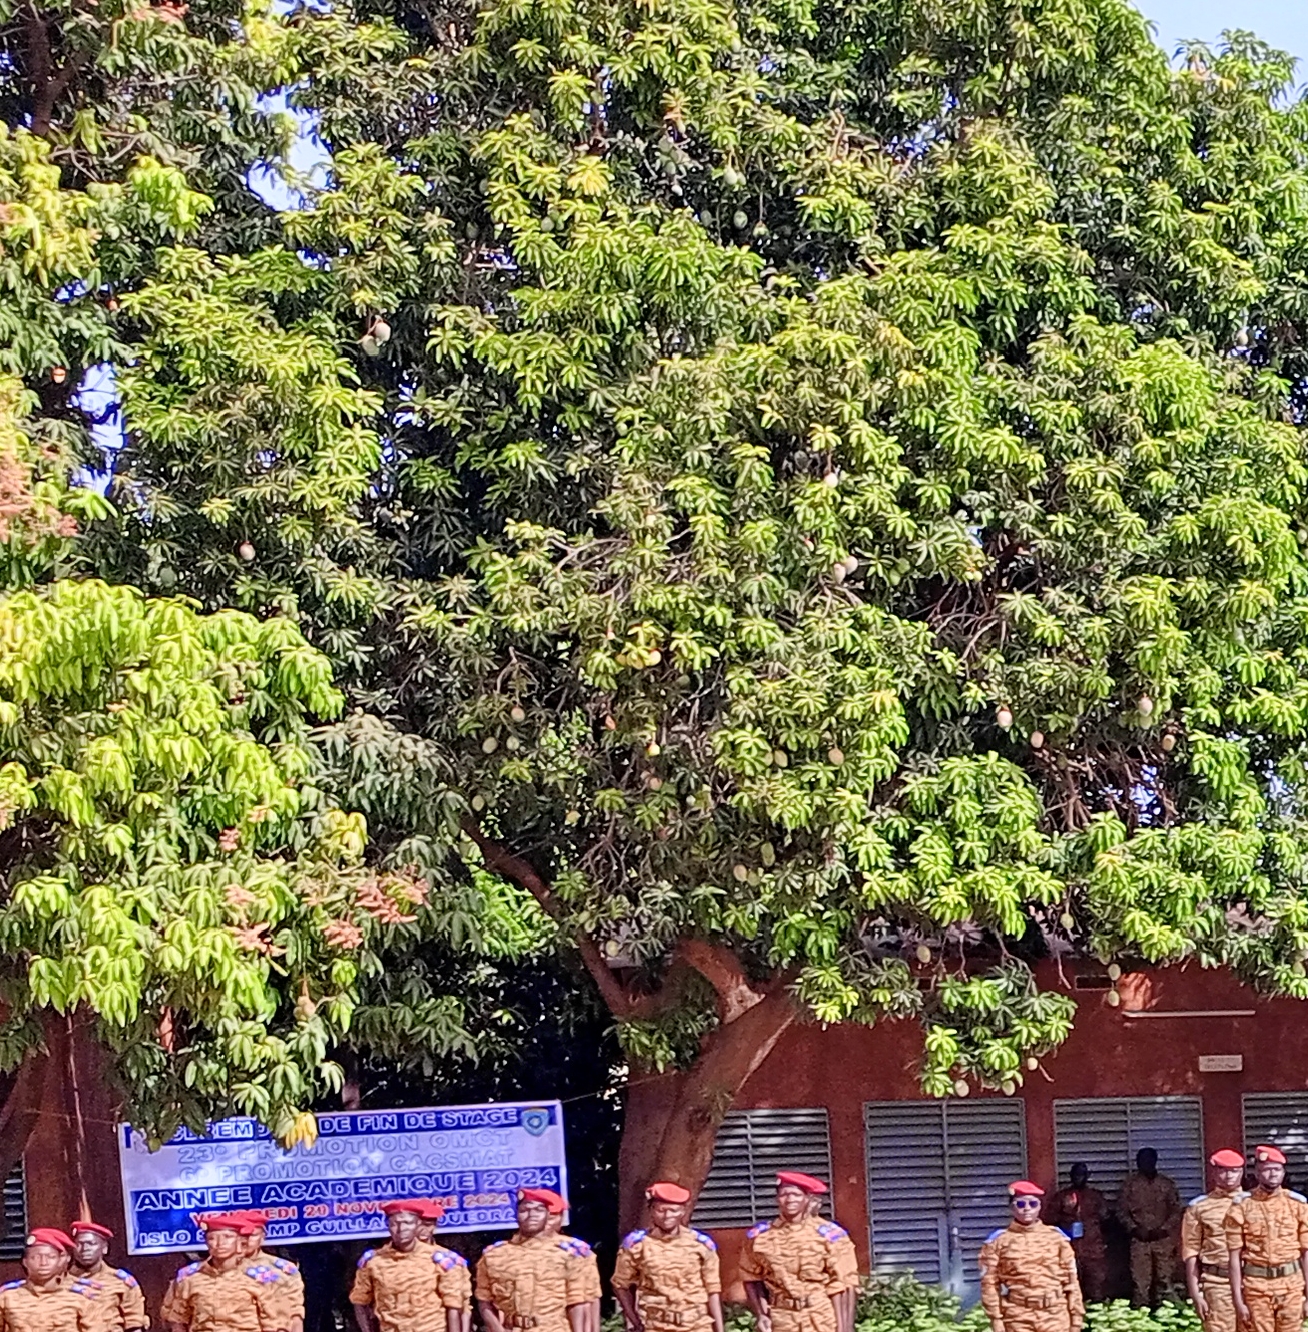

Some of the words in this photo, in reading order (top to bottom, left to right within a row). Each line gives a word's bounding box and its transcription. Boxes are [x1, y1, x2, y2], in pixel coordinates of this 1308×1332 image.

[319, 1115, 351, 1133] DE
[357, 1113, 398, 1132] FIN
[404, 1112, 437, 1129] DE
[442, 1107, 519, 1127] STAGE
[429, 1129, 512, 1149] OMCT
[216, 1156, 382, 1183] PROMOTION
[135, 1186, 252, 1211] ANNEE
[261, 1172, 476, 1204] ACADEMIQUE
[484, 1168, 558, 1189] 2024
[463, 1192, 511, 1208] 2024
[140, 1229, 191, 1246] ISLO
